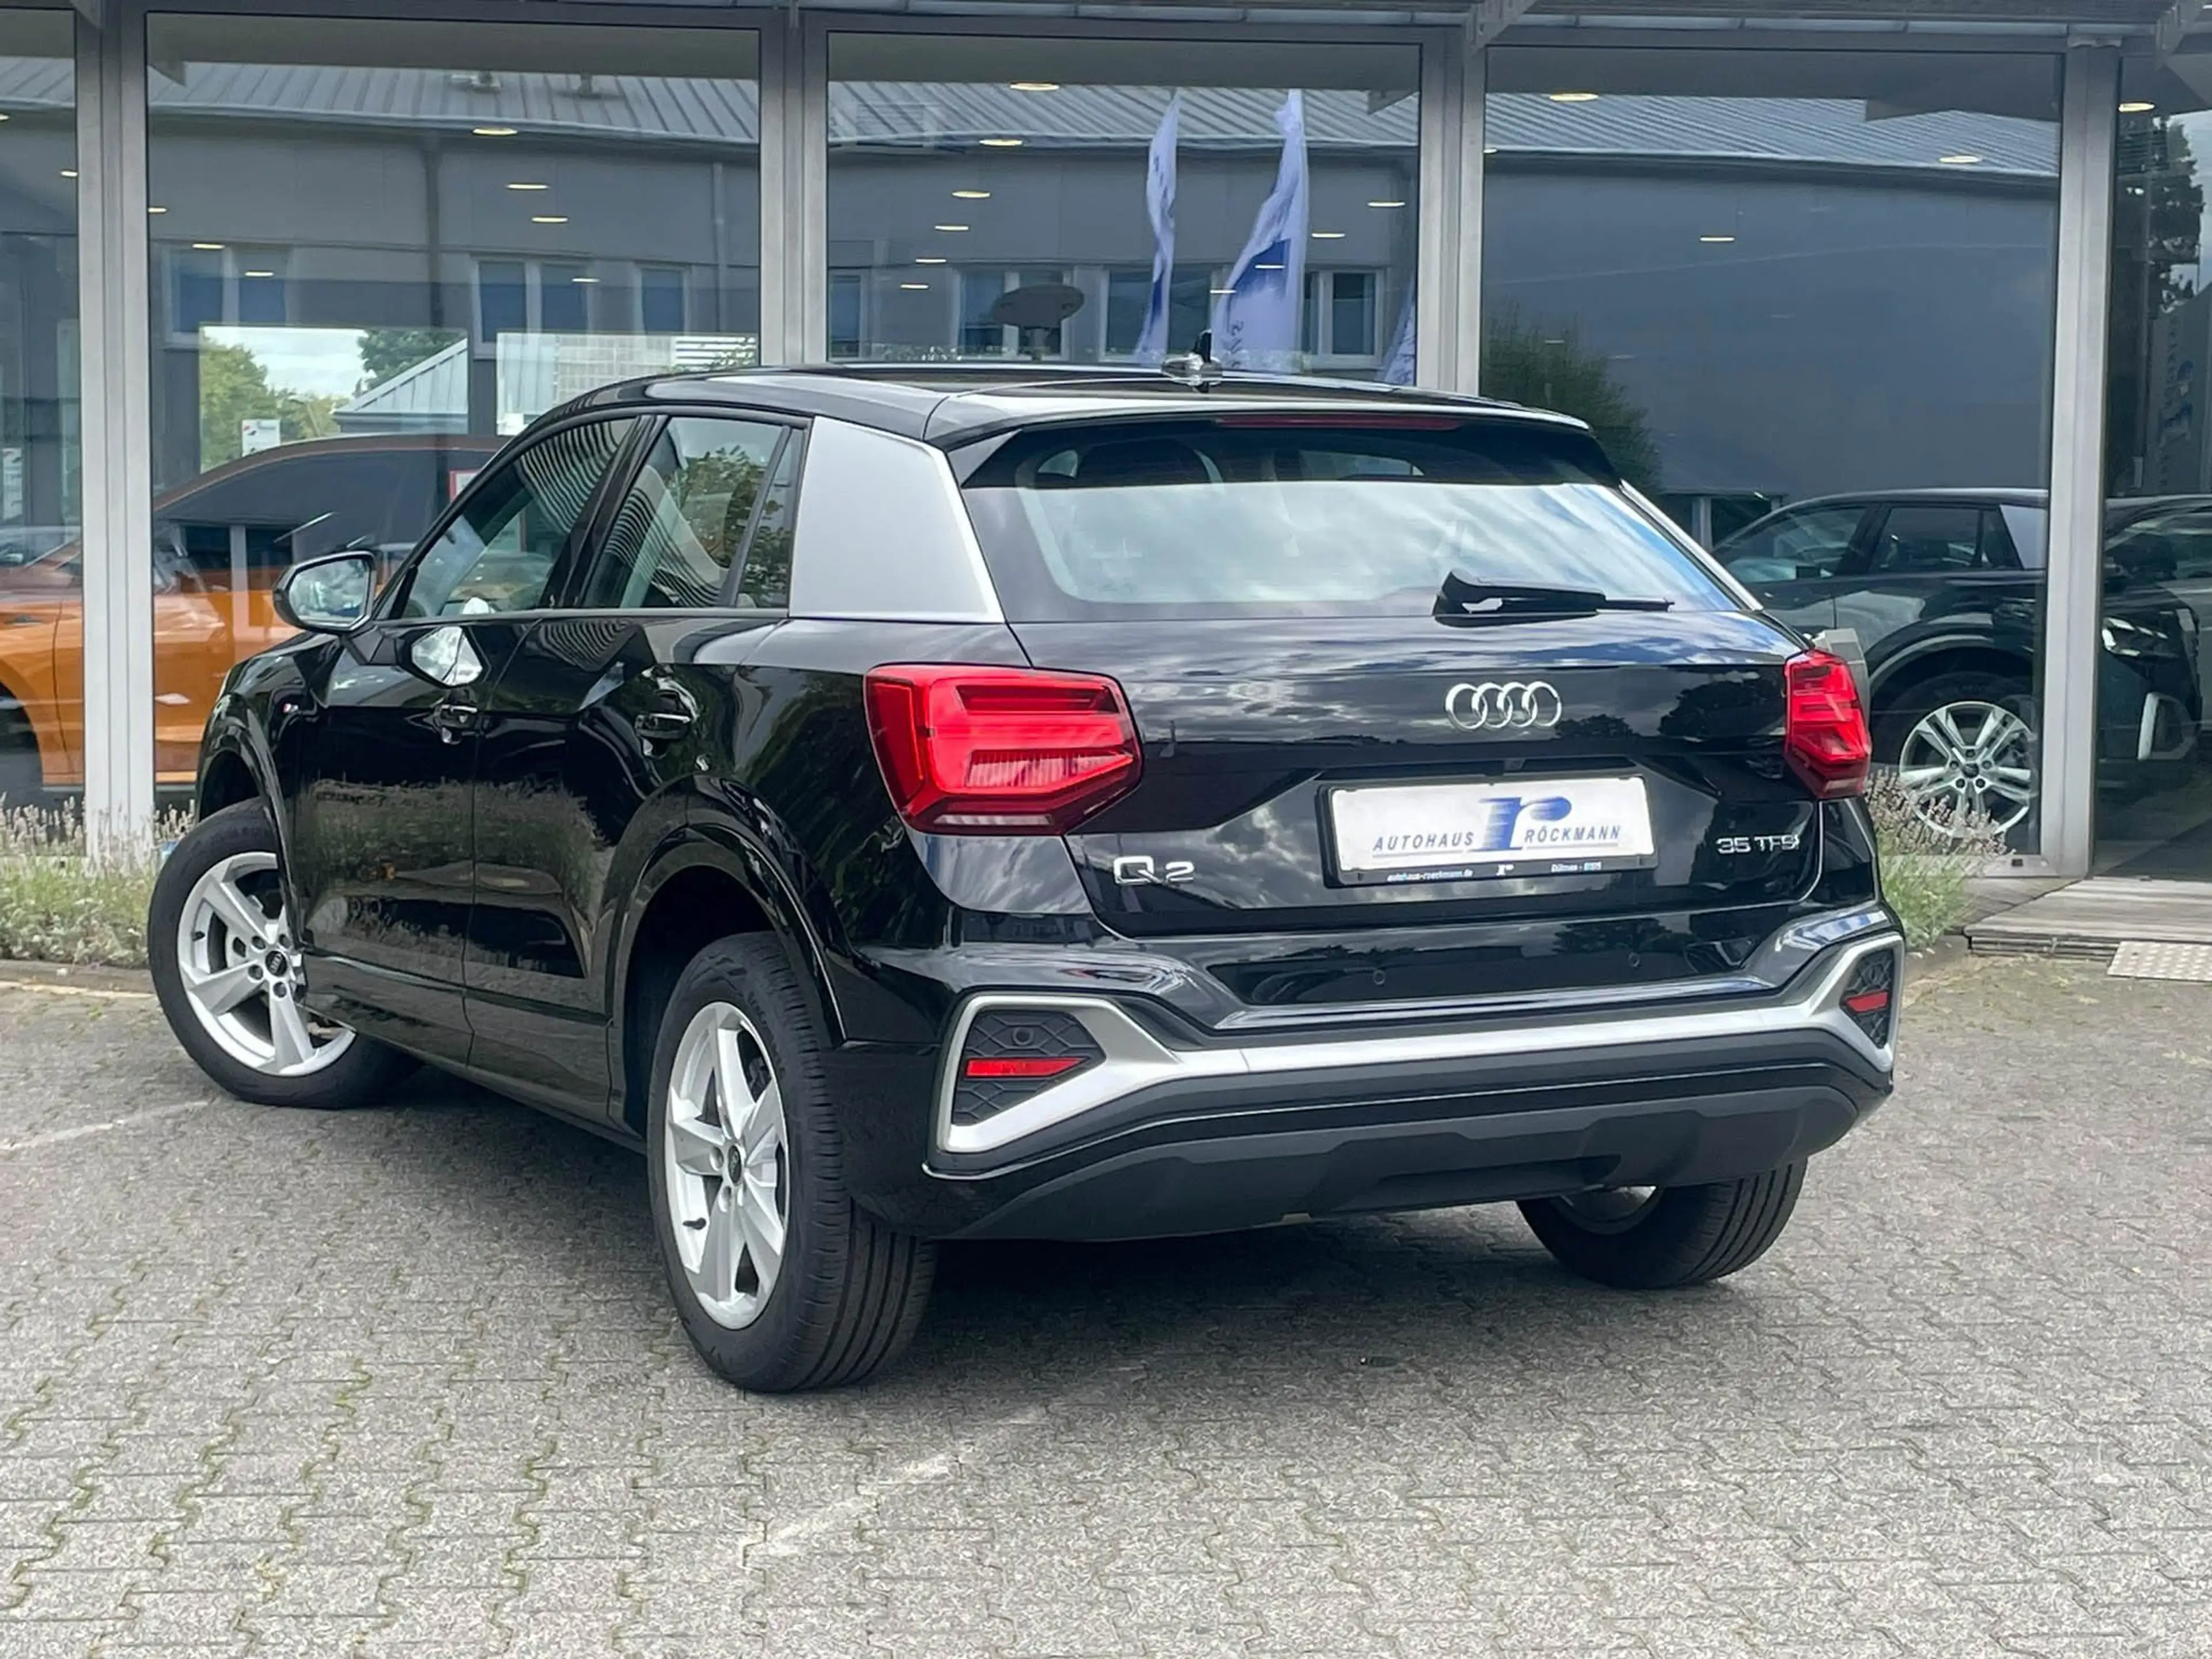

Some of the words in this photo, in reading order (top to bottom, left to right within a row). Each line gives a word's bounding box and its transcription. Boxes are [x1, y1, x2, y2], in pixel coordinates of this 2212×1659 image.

[1372, 831, 1475, 852] AUTOHAUS
[1524, 824, 1621, 844] RÖCKMANN
[1715, 836, 1752, 854] 35
[1113, 855, 1195, 885] Q2
